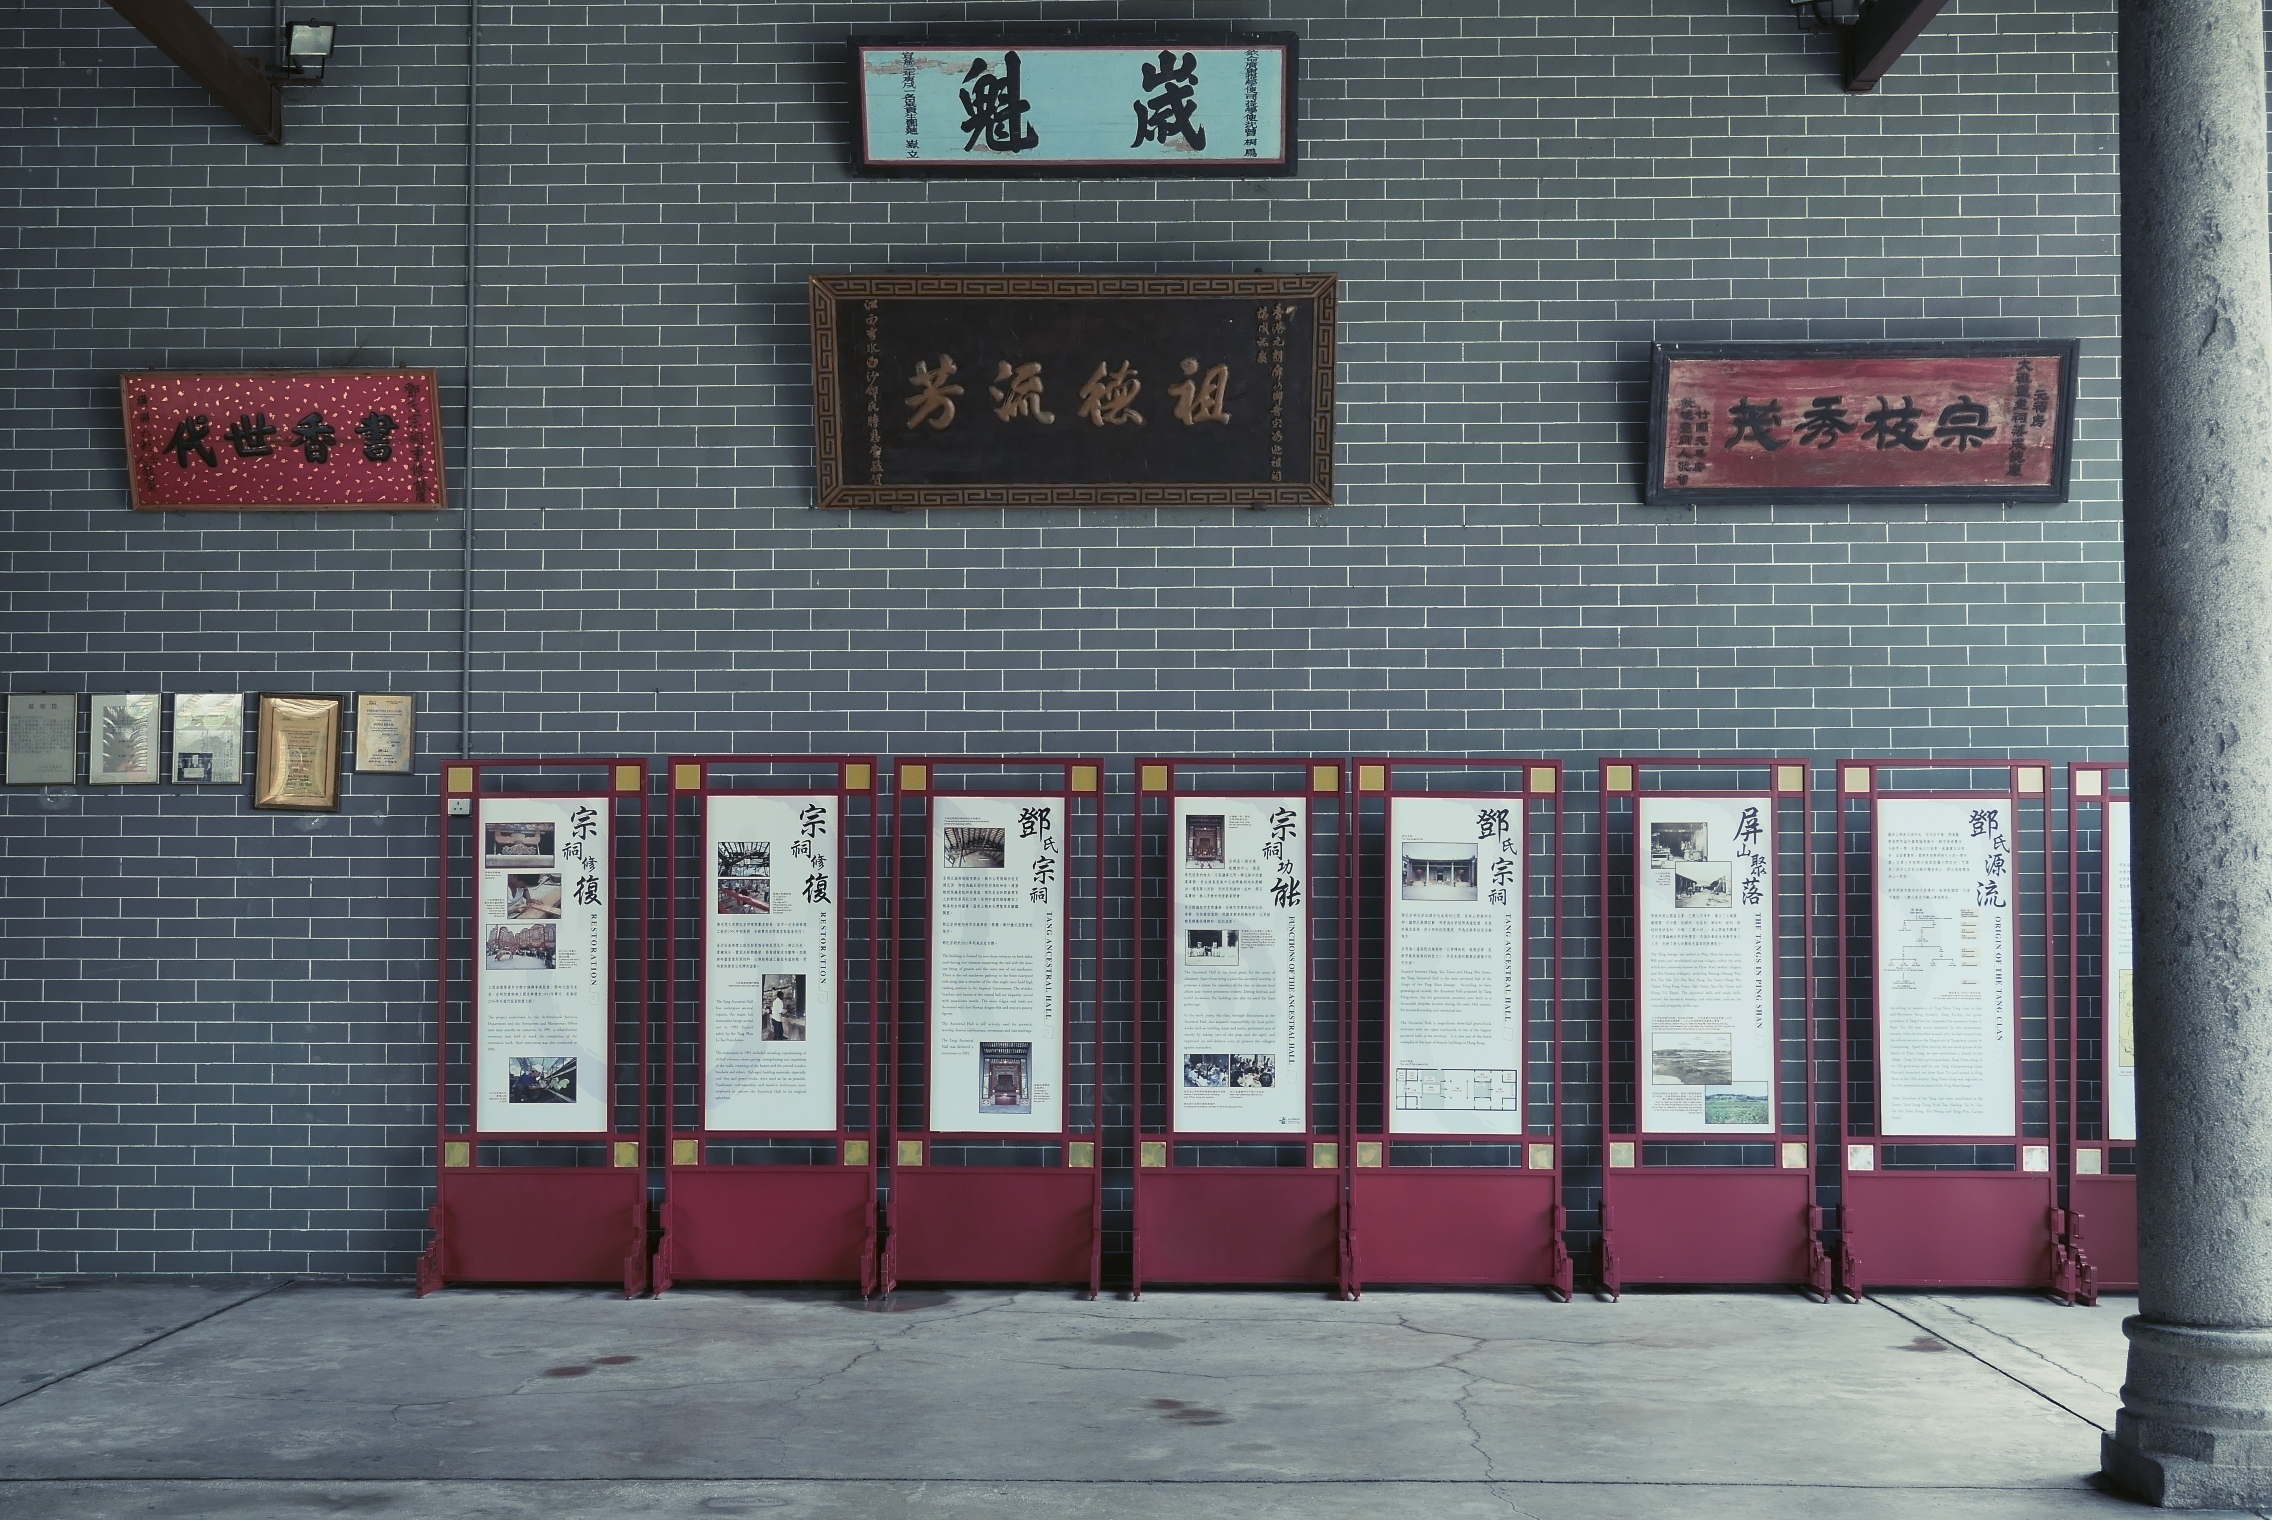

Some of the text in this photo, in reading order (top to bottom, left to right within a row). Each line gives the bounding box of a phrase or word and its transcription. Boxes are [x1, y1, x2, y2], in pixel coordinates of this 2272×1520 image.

[163, 411, 399, 468] 書香世代
[906, 354, 1231, 430] 祖德流芳
[1724, 394, 1997, 452] 宗枝秀茂
[562, 806, 602, 906] 宗祠修復
[791, 804, 831, 904] 宗祠修復
[1018, 807, 1059, 904] 鄧氏宗祠
[1262, 807, 1302, 908] 宗祠功能
[1477, 809, 1517, 905] 鄧氏宗祠
[1733, 807, 1767, 905] 屏山聚落
[1969, 809, 2010, 907] 鄧氏源流
[1289, 964, 1295, 975] OF
[1756, 966, 1762, 976] IN
[1996, 952, 2002, 964] OF
